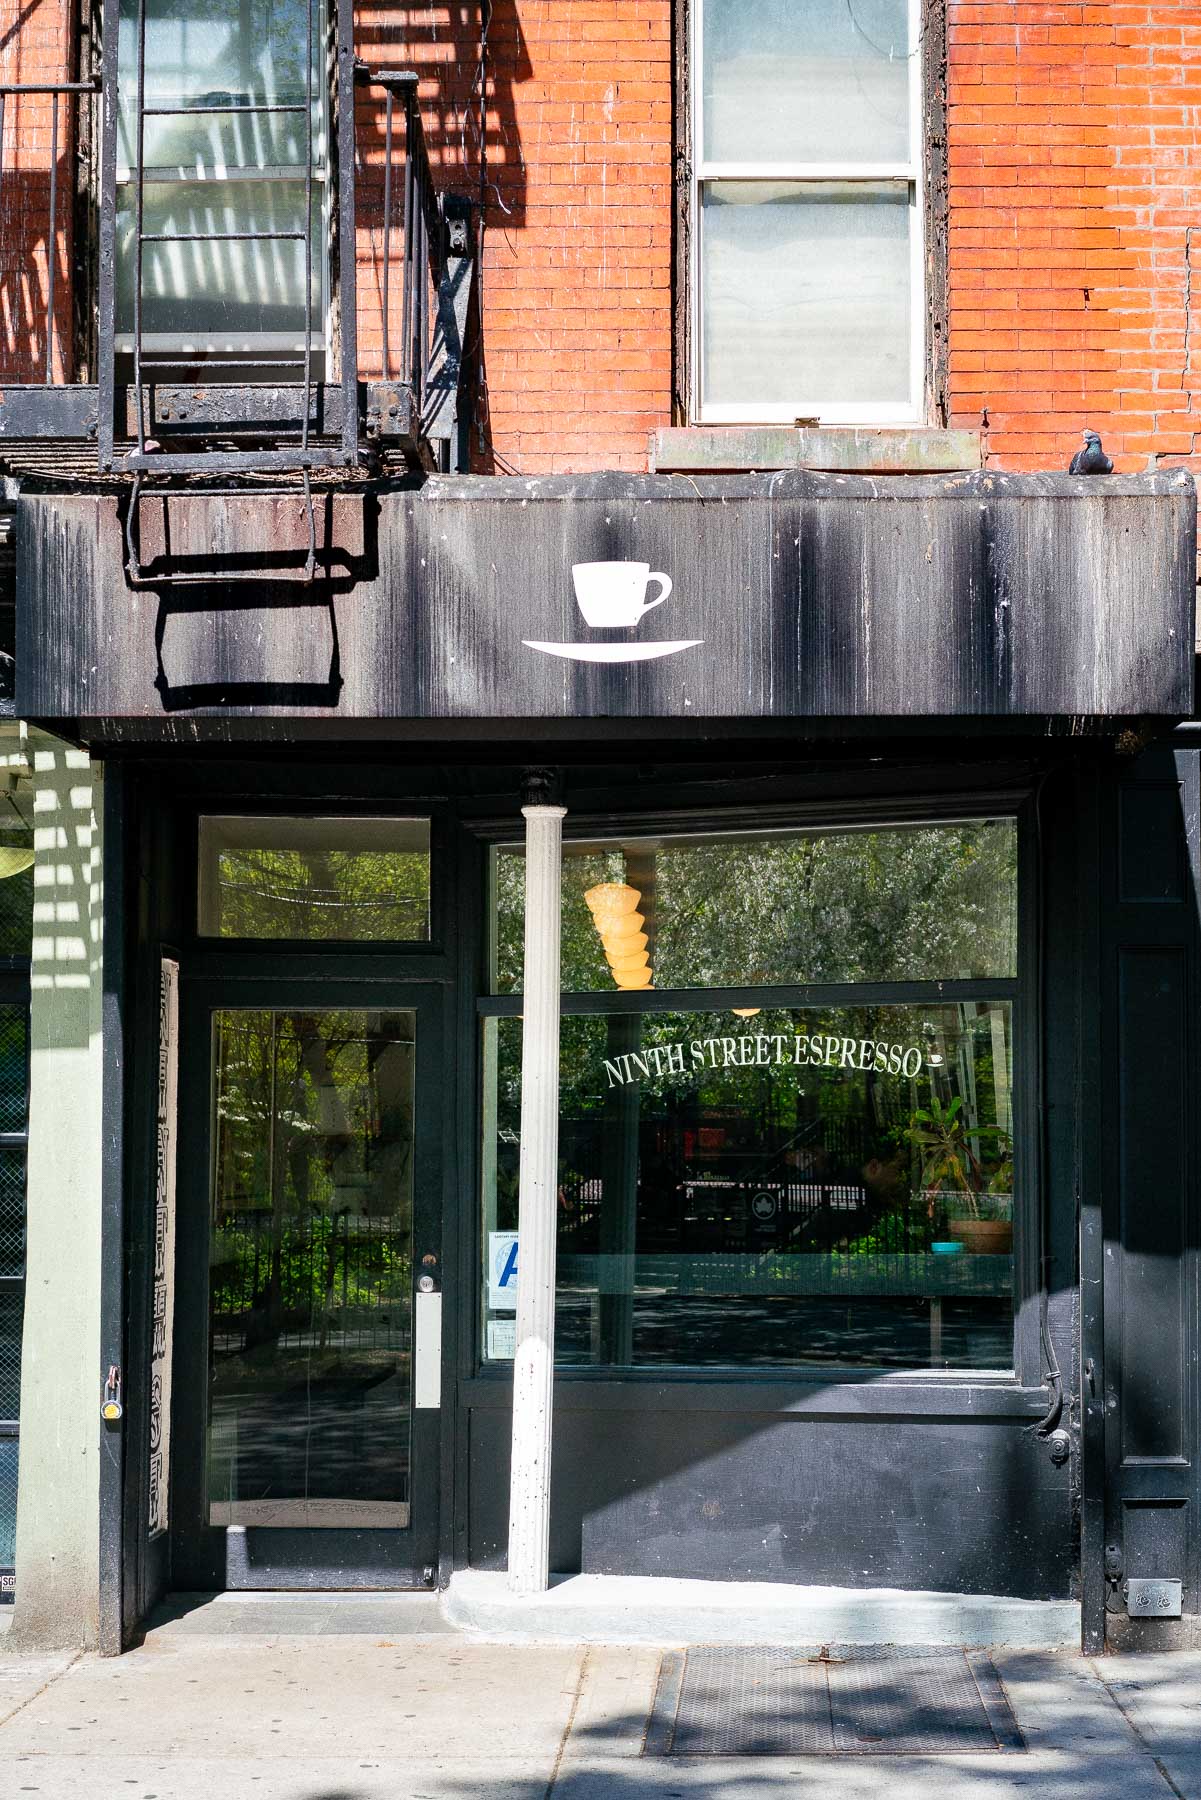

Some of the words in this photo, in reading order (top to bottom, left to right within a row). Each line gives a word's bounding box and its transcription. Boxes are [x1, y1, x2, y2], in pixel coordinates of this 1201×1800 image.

[602, 1043, 687, 1088] NINTH
[690, 1035, 788, 1071] STREET
[793, 1035, 922, 1077] ESPRESSO
